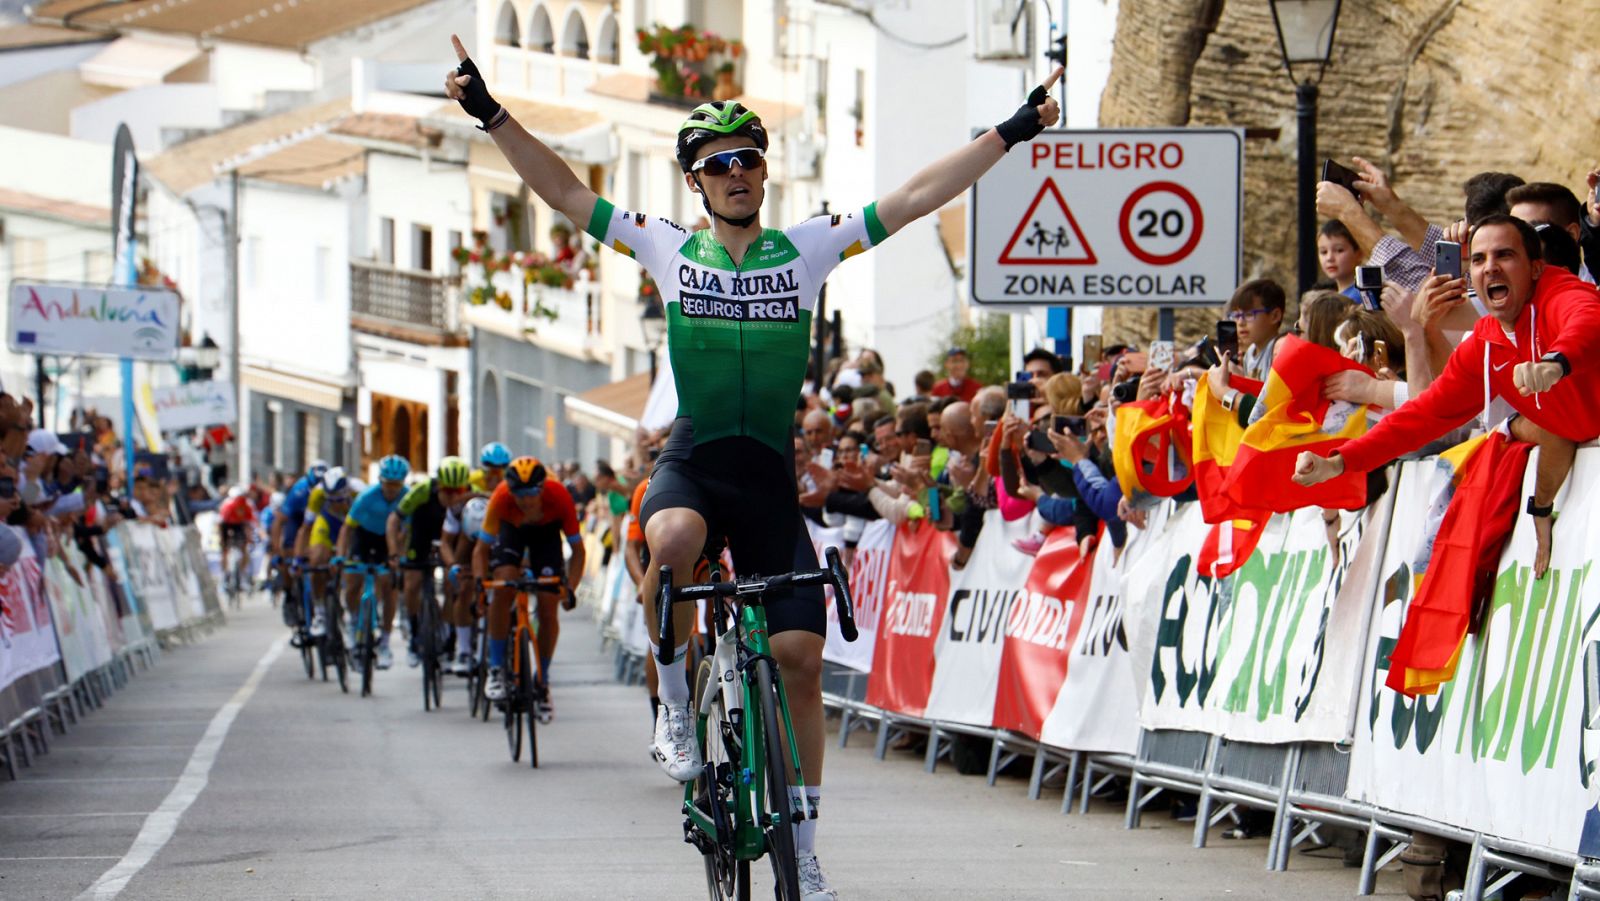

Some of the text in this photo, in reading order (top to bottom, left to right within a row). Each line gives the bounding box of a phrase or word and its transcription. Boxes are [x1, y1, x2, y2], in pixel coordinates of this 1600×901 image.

[1030, 142, 1184, 170] PELIGRO
[1136, 209, 1184, 238] 20
[679, 264, 799, 297] CAJA RURAL
[1003, 275, 1207, 296] ZONA ESCOLAR
[23, 286, 168, 329] Andalucía
[682, 296, 797, 319] SEGUROS RGA
[950, 588, 1016, 644] CIVI
[1005, 586, 1075, 650] ONDA
